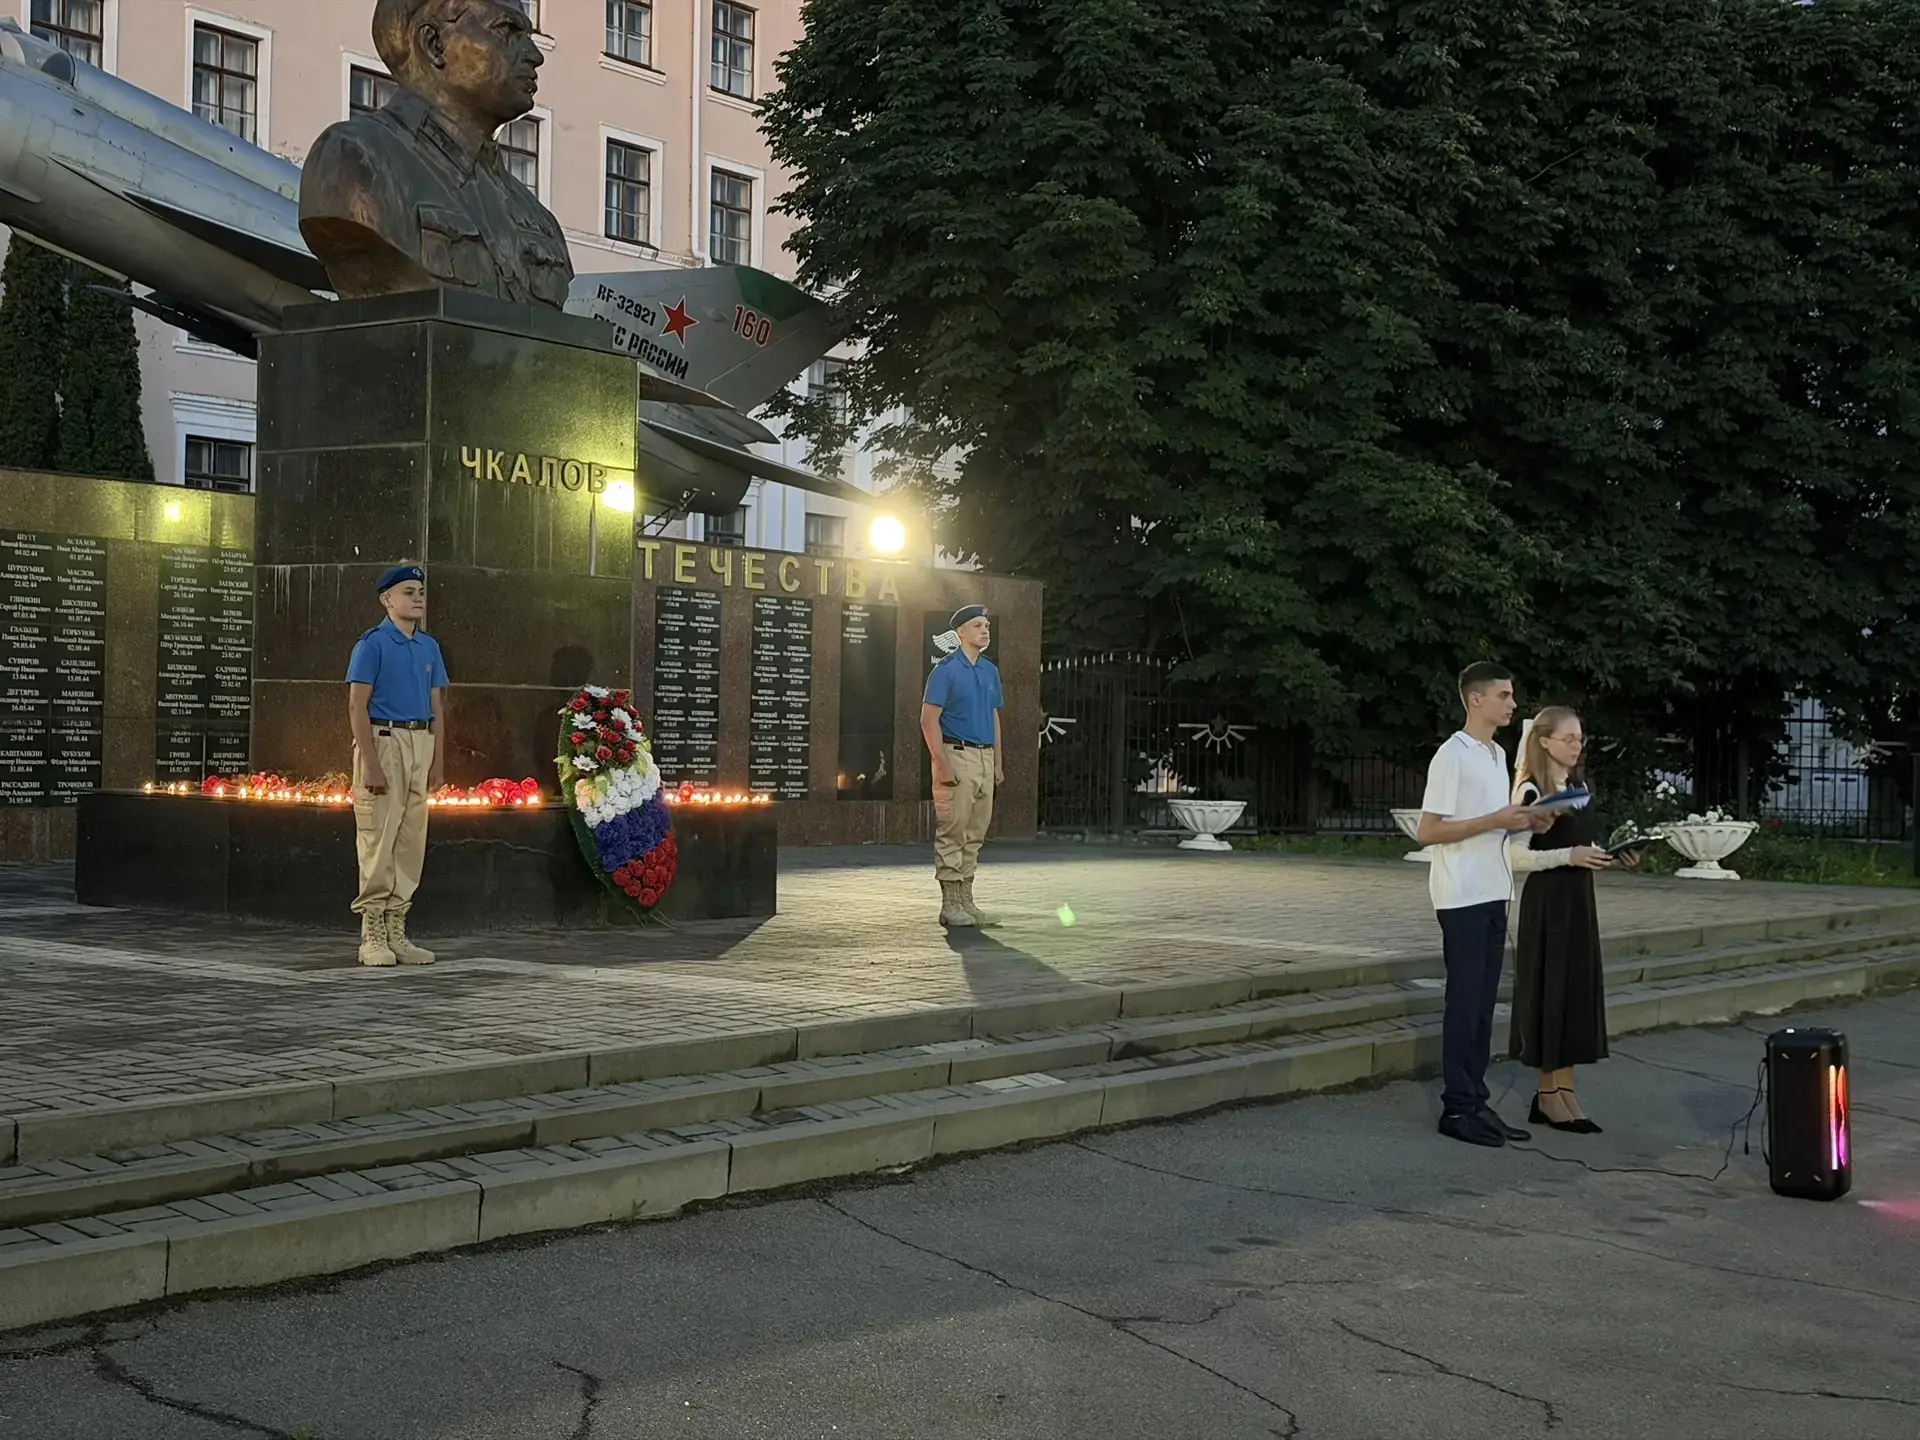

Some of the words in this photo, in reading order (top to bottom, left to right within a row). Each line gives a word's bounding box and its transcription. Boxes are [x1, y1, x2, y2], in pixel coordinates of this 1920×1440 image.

[596, 283, 657, 327] RF-32921
[732, 304, 772, 347] 160
[627, 333, 690, 380] РОССИИ
[461, 445, 608, 493] ЧКАЛОВ
